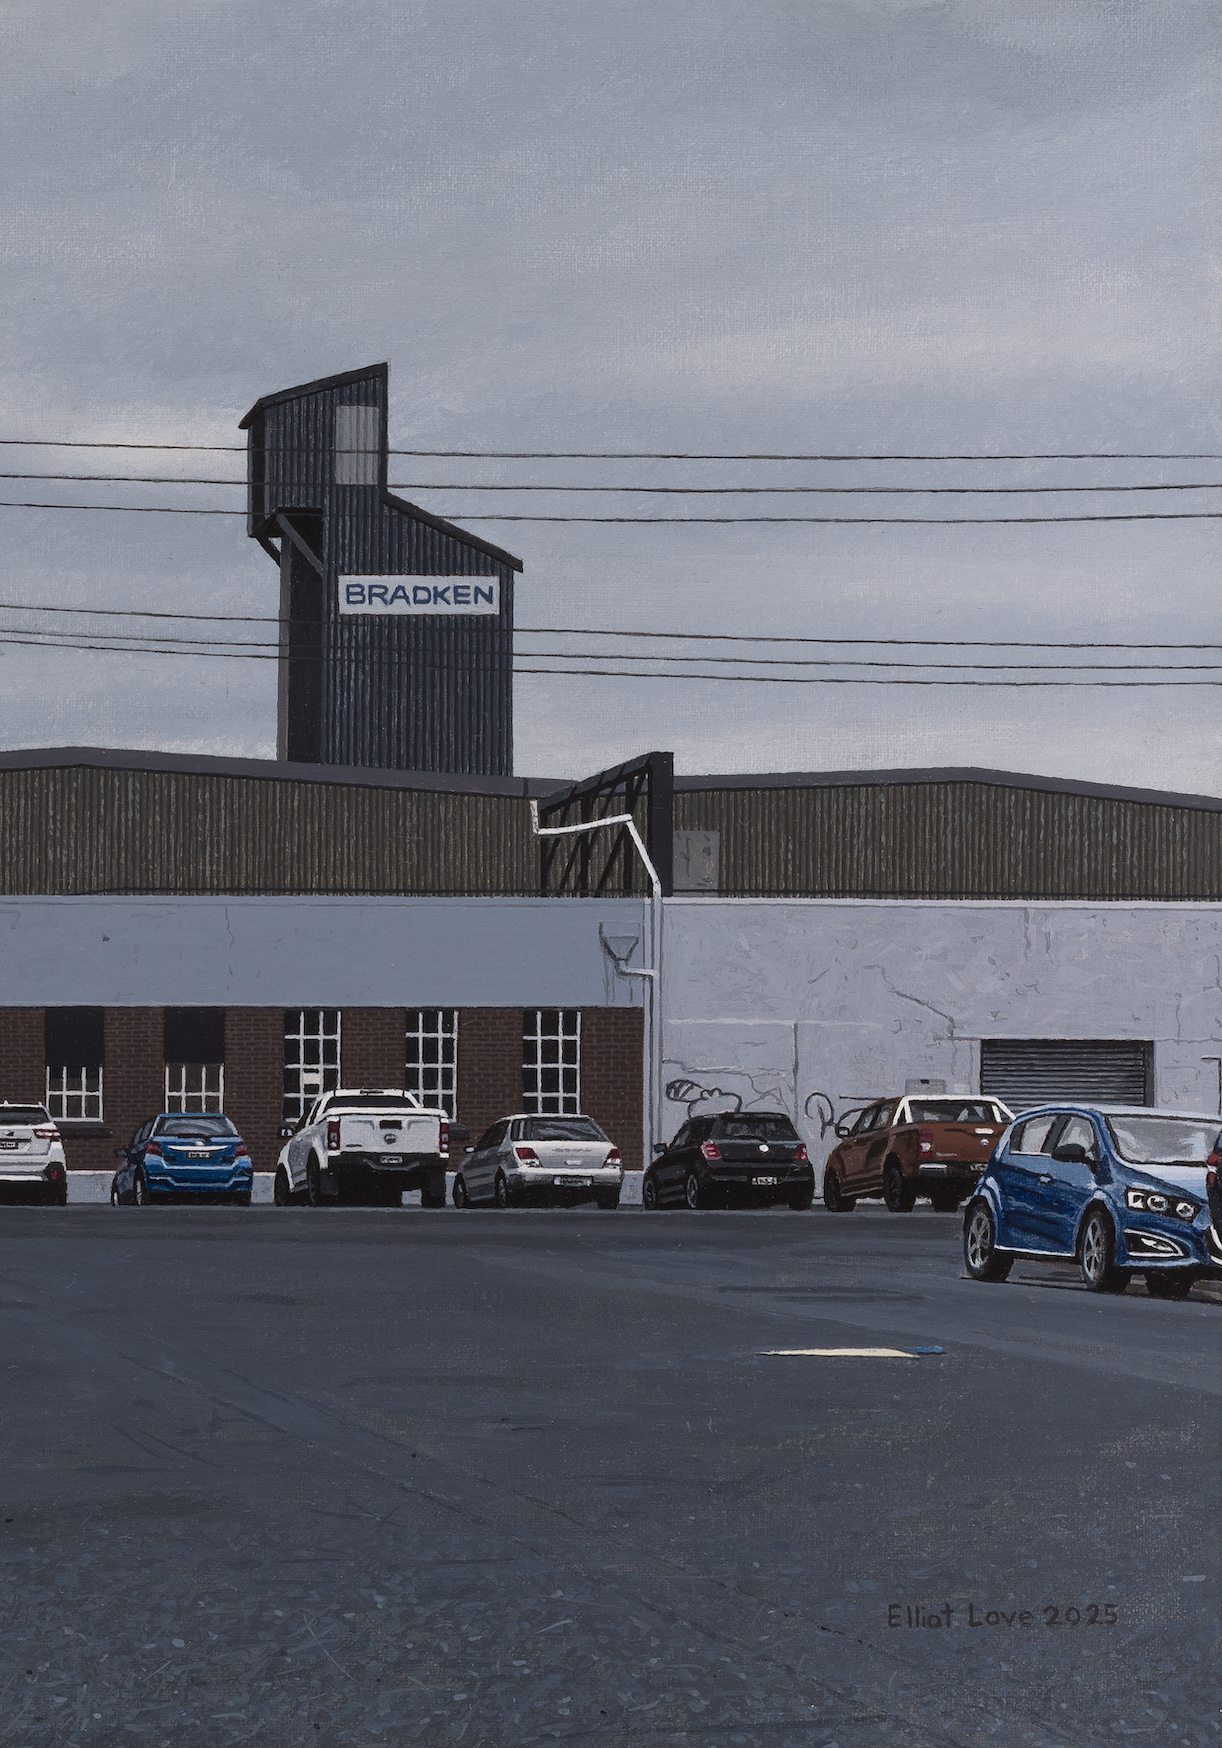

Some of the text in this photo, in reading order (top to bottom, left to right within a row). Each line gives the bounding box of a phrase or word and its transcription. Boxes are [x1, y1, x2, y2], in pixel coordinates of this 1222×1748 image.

[345, 583, 494, 606] BRADKEN
[887, 1602, 1119, 1628] Elliot Love 2025
